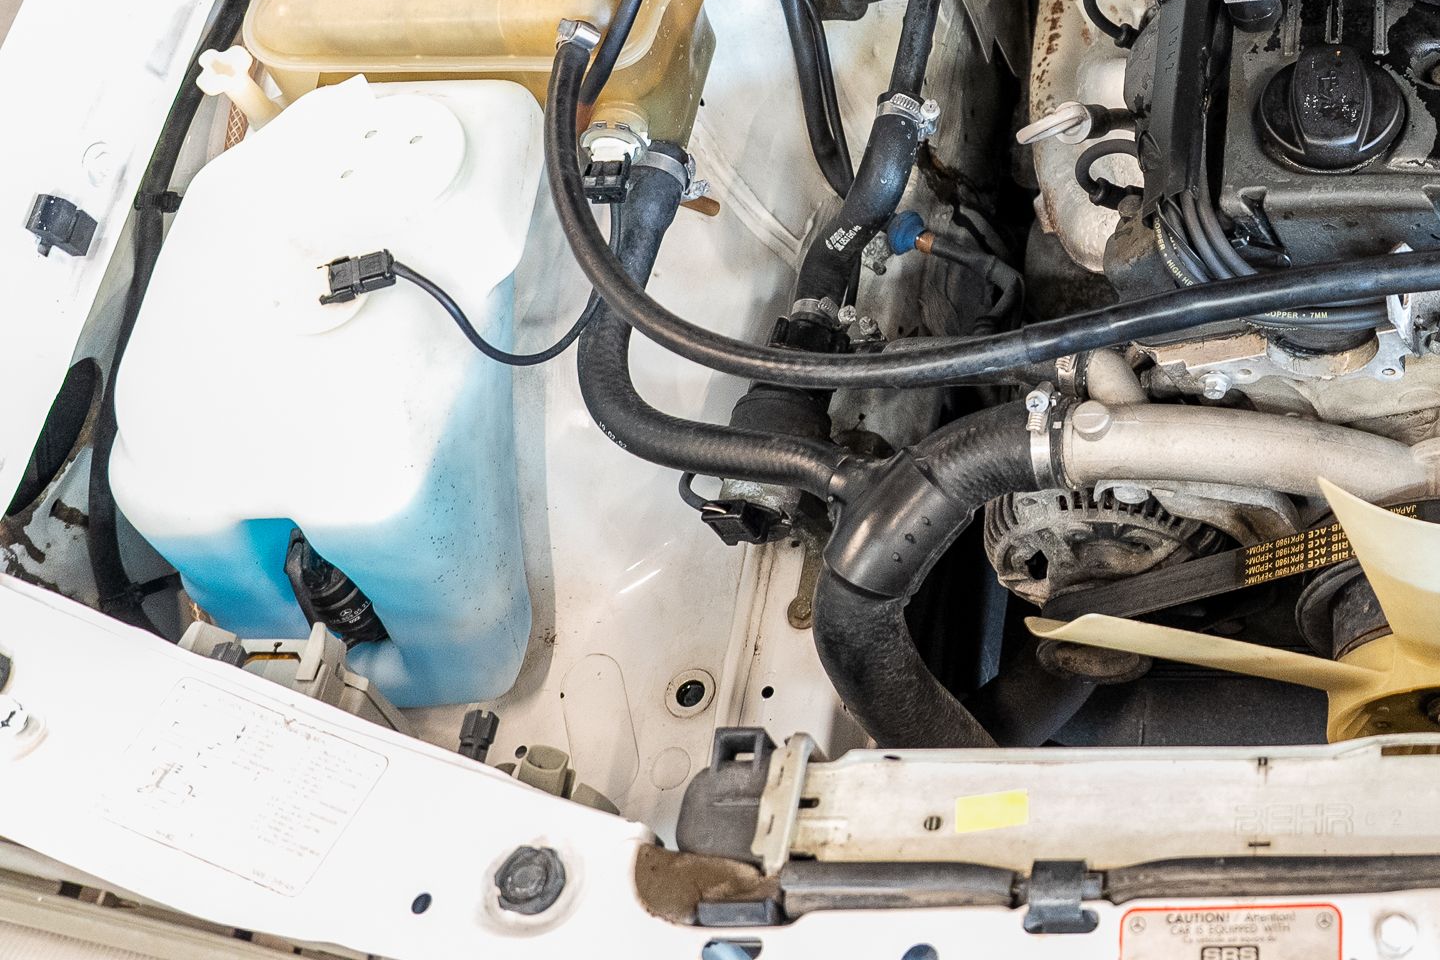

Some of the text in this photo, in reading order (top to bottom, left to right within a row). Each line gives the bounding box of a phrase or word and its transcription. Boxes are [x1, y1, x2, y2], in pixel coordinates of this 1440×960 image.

[1166, 259, 1183, 279] HIGH
[1182, 274, 1194, 287] HE
[1309, 311, 1328, 319] 7MM
[1275, 533, 1304, 548] 6PK1980
[1308, 523, 1343, 538] IB-ACE
[1275, 542, 1304, 557] 6PK1980
[1275, 553, 1304, 567] 6PK1980
[1308, 541, 1349, 557] RIB-ACE
[1275, 563, 1304, 579] 6PK1980
[1308, 551, 1349, 569] RIB-ACE
[1235, 803, 1354, 835] BEHR
[1166, 913, 1230, 924] CAUTION!
